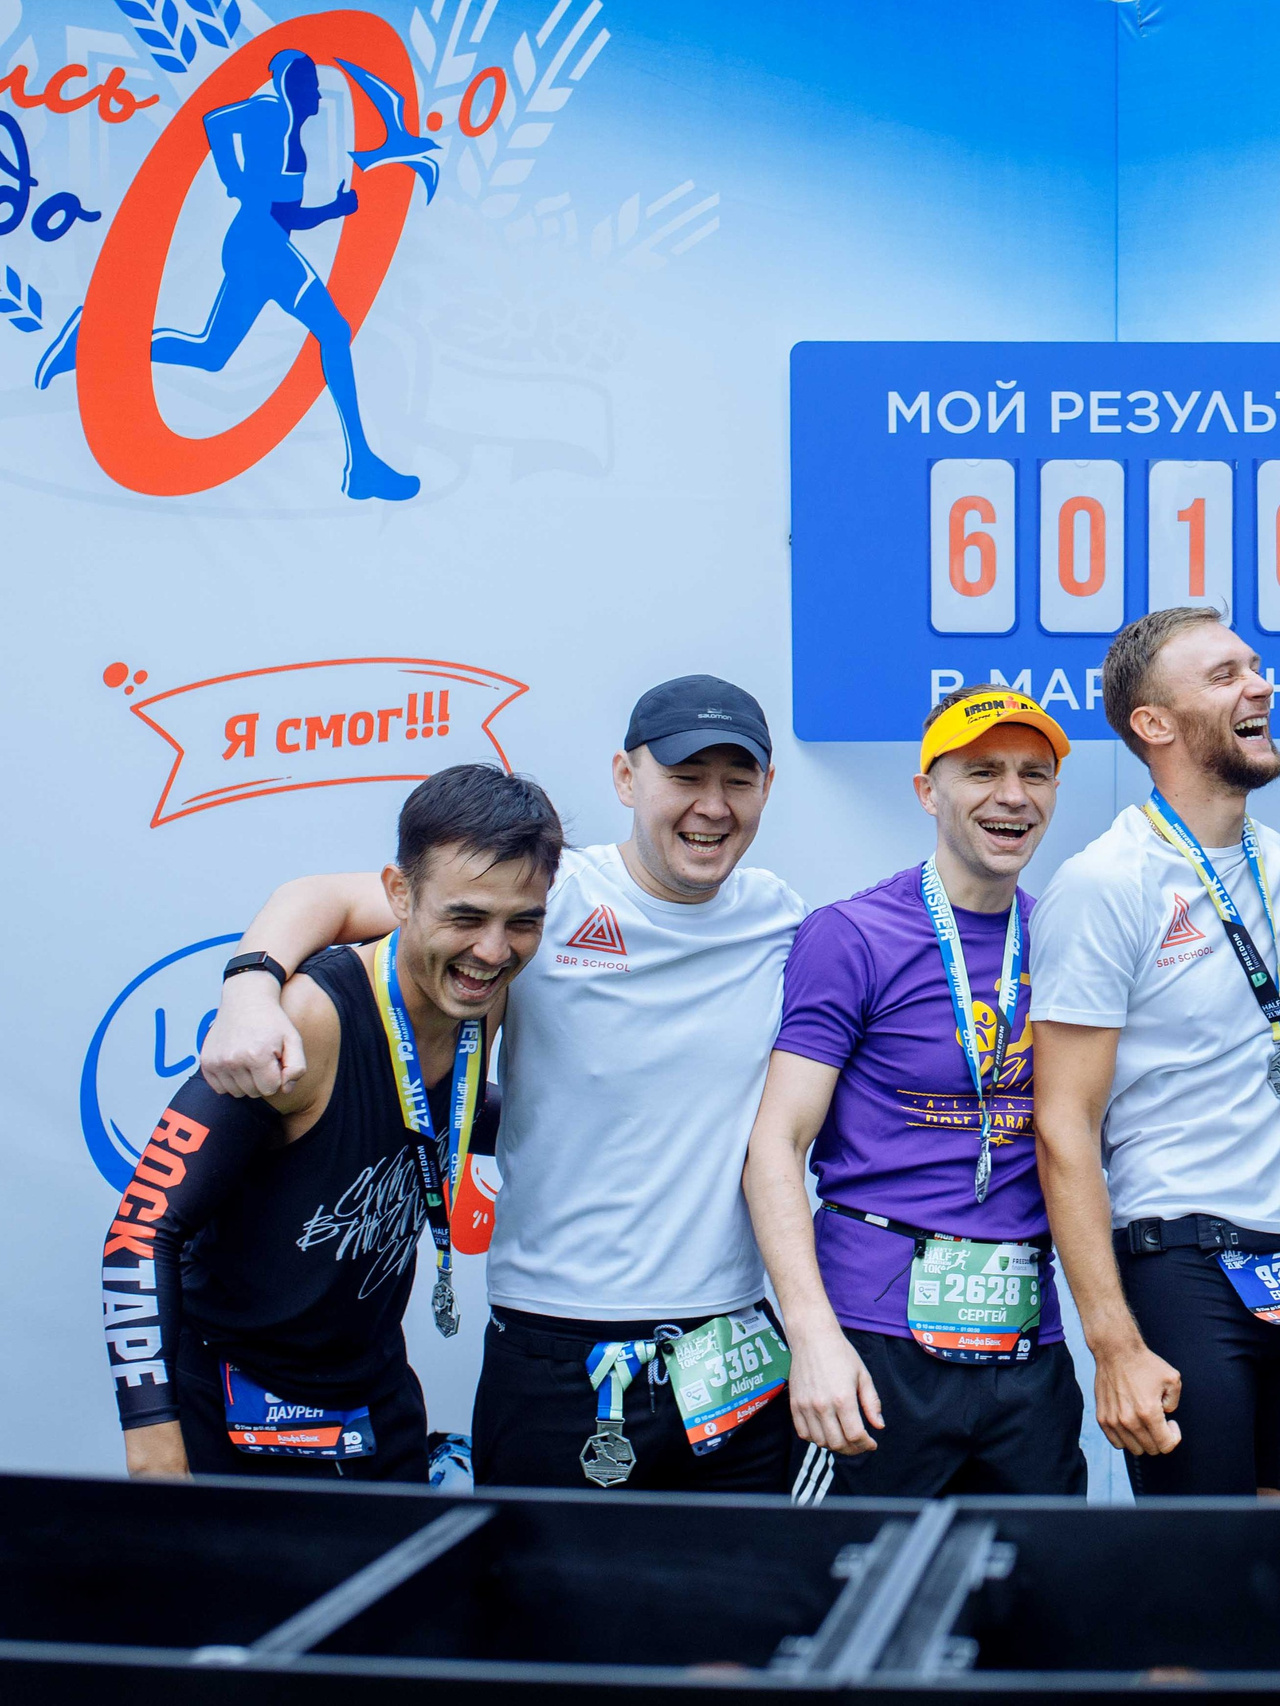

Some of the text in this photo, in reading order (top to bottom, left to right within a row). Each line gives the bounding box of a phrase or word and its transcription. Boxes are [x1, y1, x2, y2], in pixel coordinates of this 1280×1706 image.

[888, 380, 1026, 434] МОЙ
[222, 690, 451, 761] Я смог!!!
[921, 858, 956, 942] FINISHER
[556, 954, 631, 972] SBR SCHOOL
[1156, 946, 1214, 968] SBR SCHOOL
[1232, 932, 1255, 972] FREEDOM
[995, 1025, 1005, 1065] FREEDOM
[417, 1145, 432, 1188] FREEDOM
[432, 1227, 449, 1236] HALF
[924, 1251, 952, 1261] HALF
[944, 1273, 1021, 1305] 2628
[958, 1307, 1007, 1322] СЕРГЕЙ
[958, 1336, 984, 1346] Альфа
[704, 1336, 773, 1388] 3361
[731, 1373, 764, 1397] Aldiyar
[265, 1405, 324, 1423] ДАУРЕН
